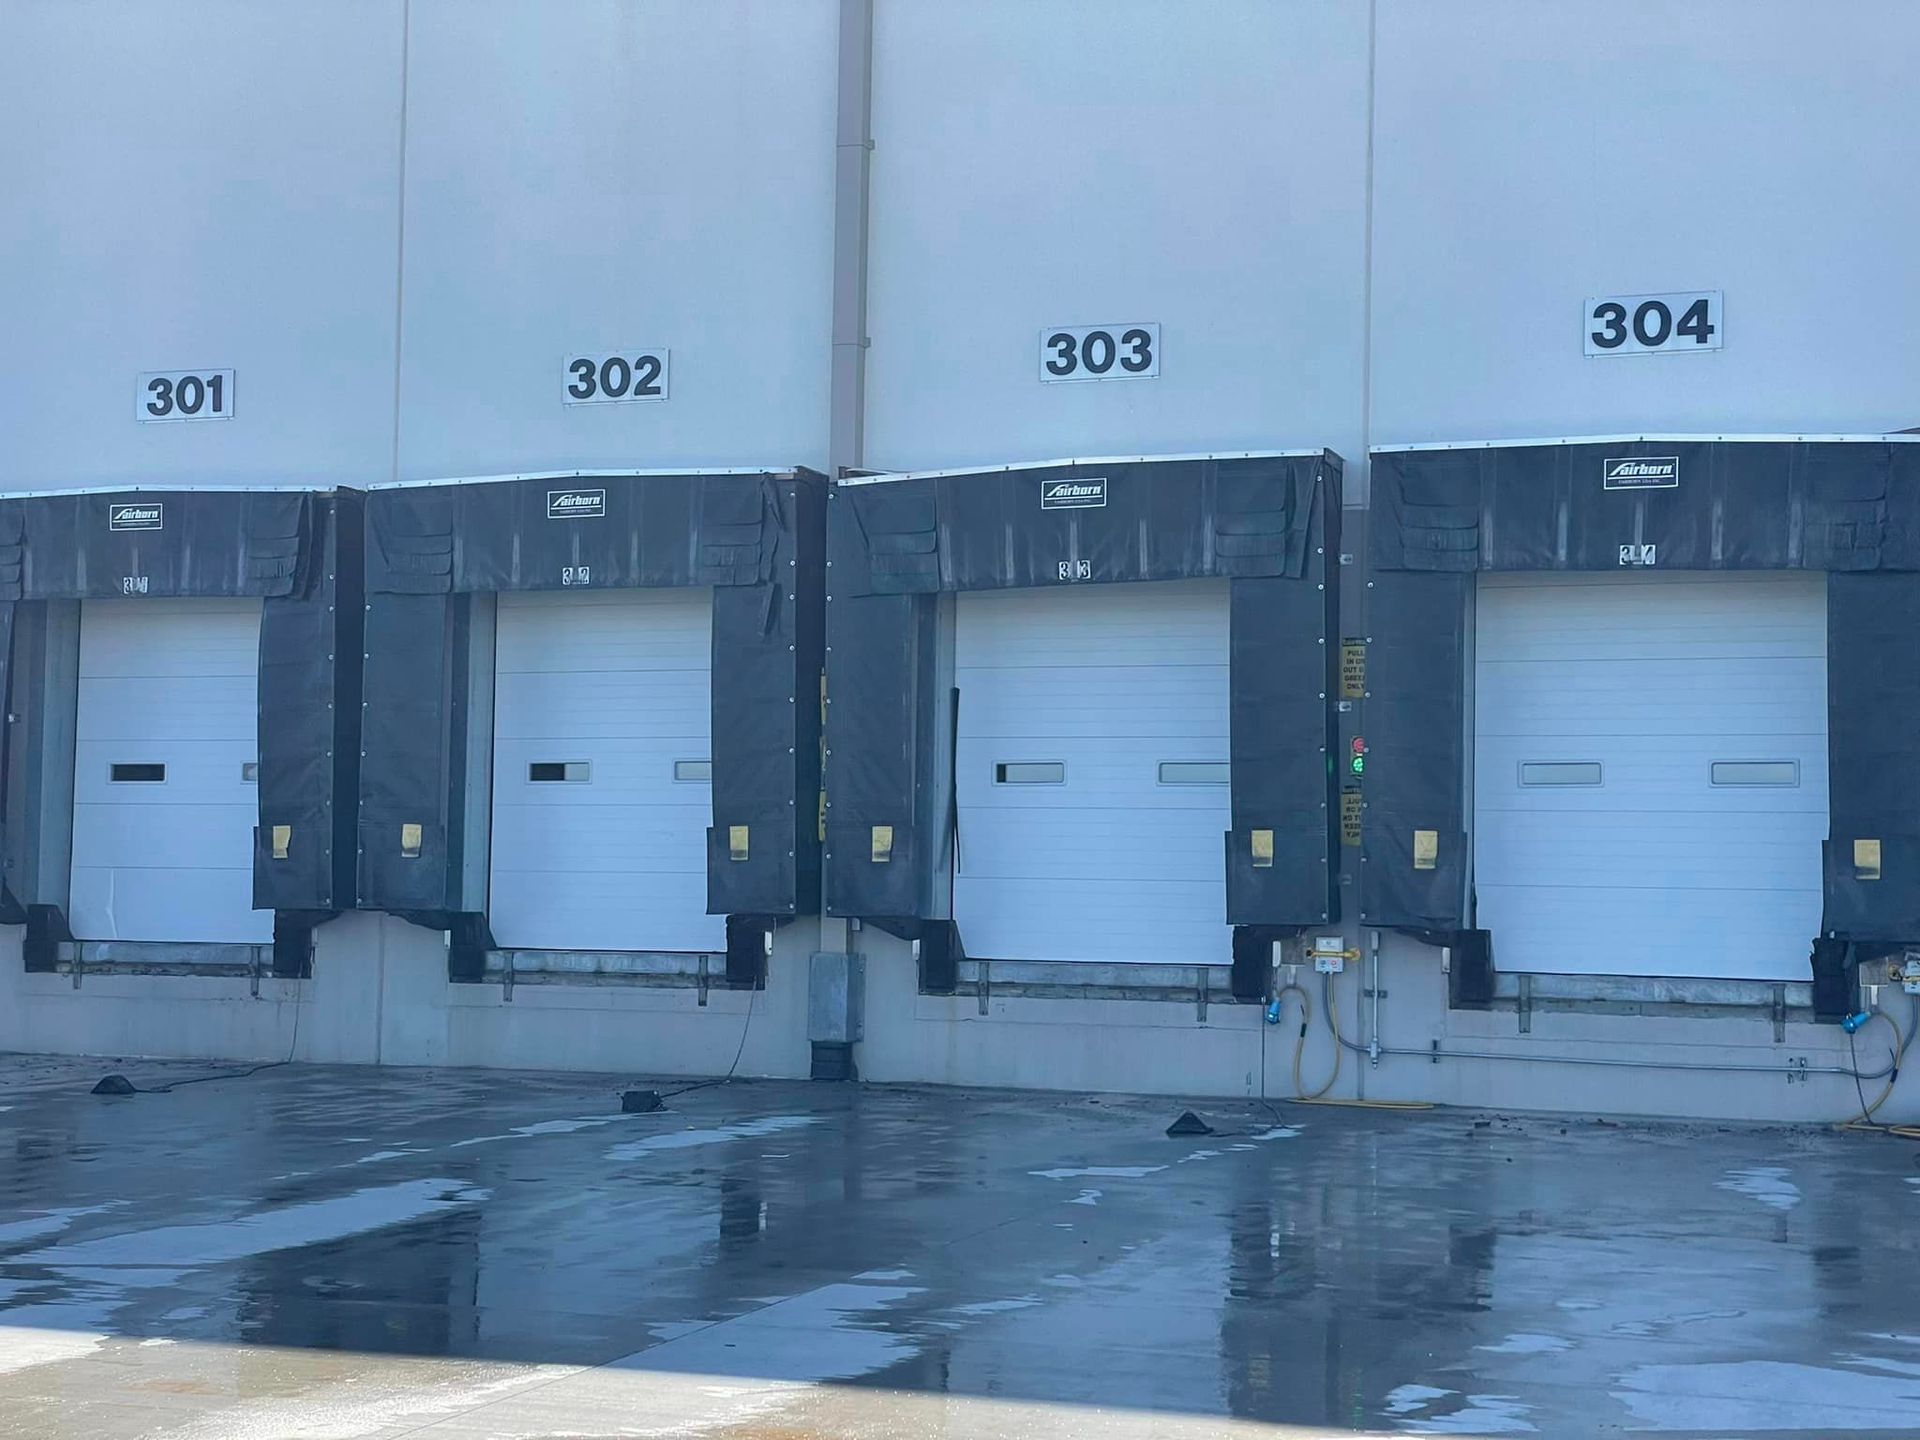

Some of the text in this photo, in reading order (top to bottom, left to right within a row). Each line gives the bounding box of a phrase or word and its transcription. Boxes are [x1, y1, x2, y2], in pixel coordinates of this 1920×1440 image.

[1591, 298, 1715, 349] 304
[1046, 329, 1153, 376] 303
[146, 374, 224, 416] 301
[568, 355, 661, 400] 302
[1060, 560, 1090, 580] 33
